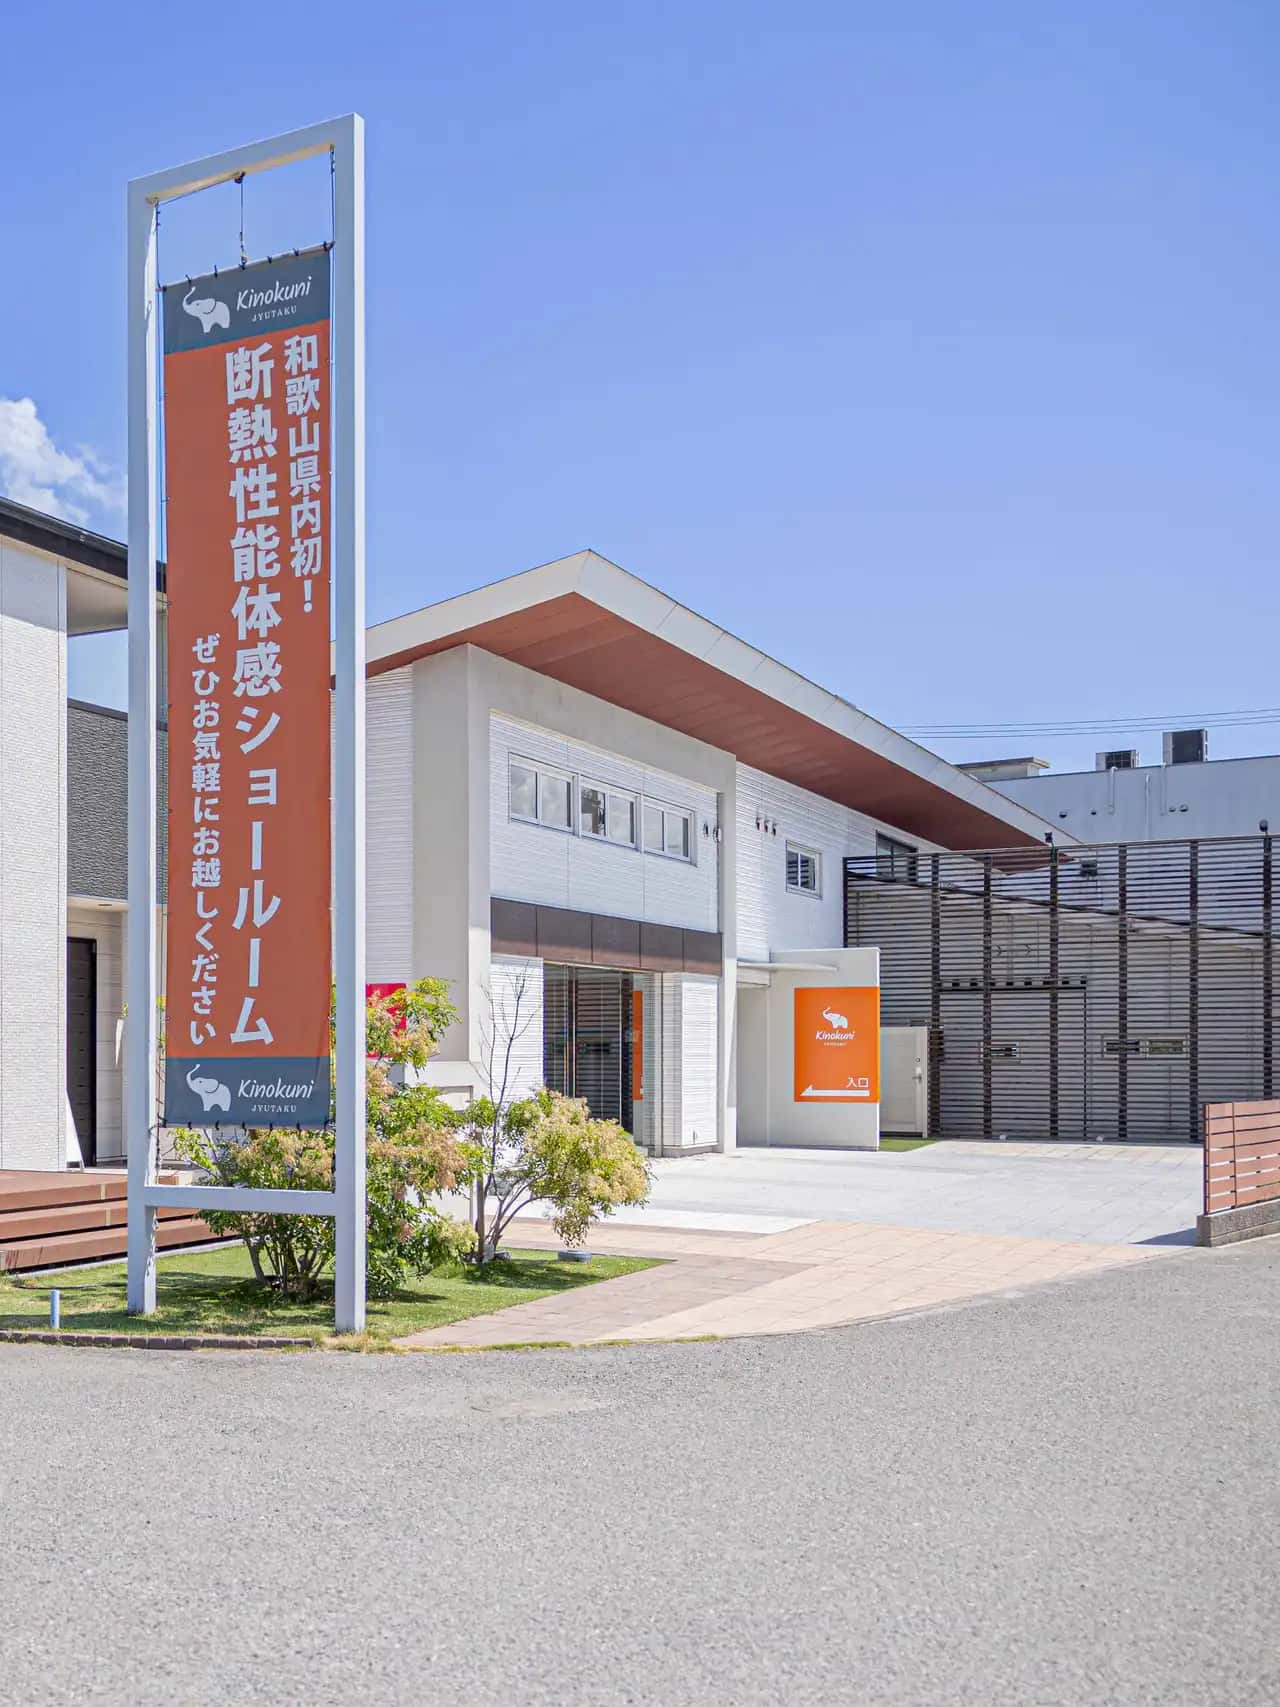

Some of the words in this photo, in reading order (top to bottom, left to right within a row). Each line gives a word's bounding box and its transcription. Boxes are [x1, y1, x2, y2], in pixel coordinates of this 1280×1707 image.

[236, 275, 313, 312] Kinokuni
[251, 305, 298, 323] JYUTAKU
[284, 334, 322, 613] 和歌山県内初！
[225, 342, 282, 1045] 断熱性能体感ショールーム
[190, 632, 221, 1046] ぜひお気軽にお越しください
[815, 1030, 855, 1040] Kinokuni
[238, 1077, 314, 1099] Kinokuni
[847, 1077, 869, 1088] 入口
[251, 1104, 297, 1113] JYUTAKU
